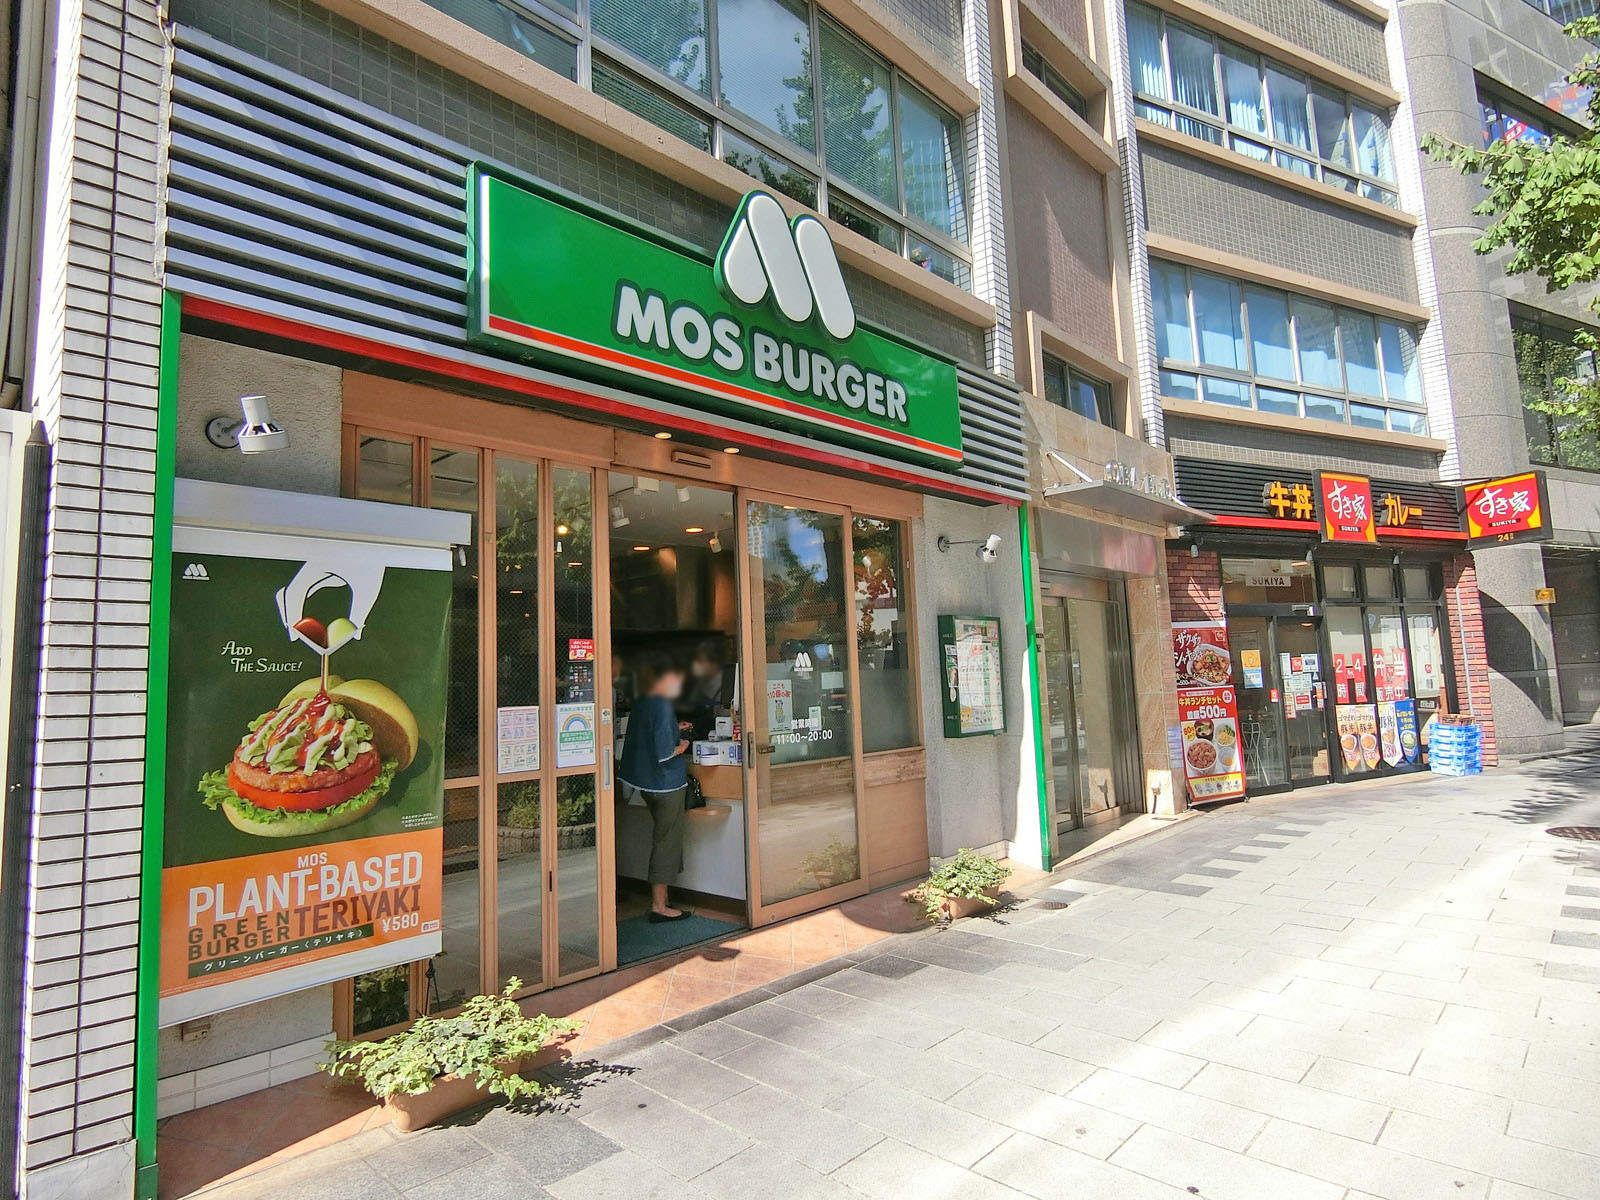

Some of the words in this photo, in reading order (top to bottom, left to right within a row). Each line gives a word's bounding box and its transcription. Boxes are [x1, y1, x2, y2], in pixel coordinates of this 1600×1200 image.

[616, 285, 744, 371] MOS
[753, 332, 908, 422] BURGER
[1269, 481, 1313, 519] 牛丼
[1327, 480, 1368, 524] すき家
[1384, 493, 1423, 526] カレー
[1475, 488, 1531, 518] すき家
[1252, 576, 1285, 585] SUKIYA
[1372, 653, 1406, 678] 弁当
[297, 852, 328, 869] MOS
[188, 851, 423, 927] PLANT-BASED
[188, 910, 290, 945] GREEN
[294, 884, 421, 937] TERIYAKI
[382, 912, 419, 933] ¥580
[188, 927, 291, 962] BURGER
